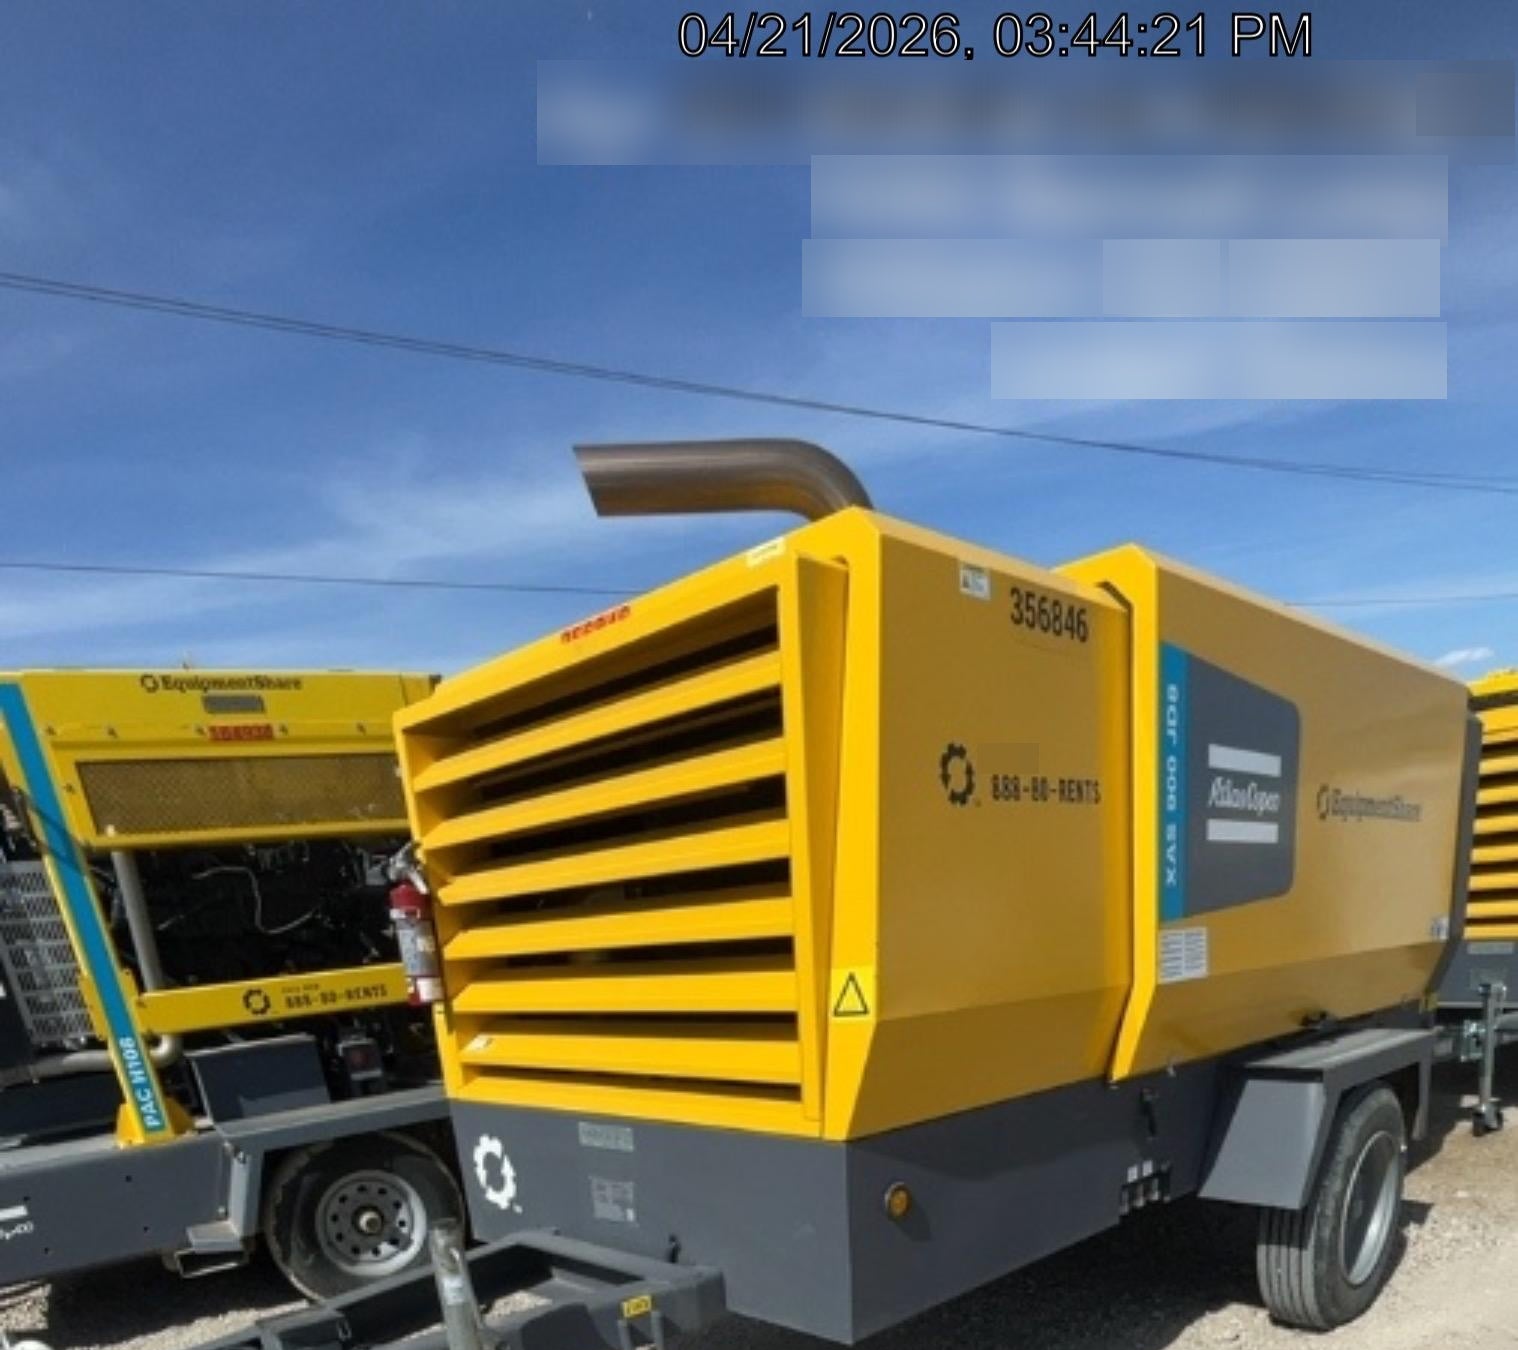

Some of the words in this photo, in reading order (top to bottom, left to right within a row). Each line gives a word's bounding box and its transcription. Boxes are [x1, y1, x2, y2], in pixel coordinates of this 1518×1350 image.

[1009, 586, 1089, 643] 356846
[161, 674, 302, 693] EquipmentShare
[134, 1087, 161, 1129] PAC
